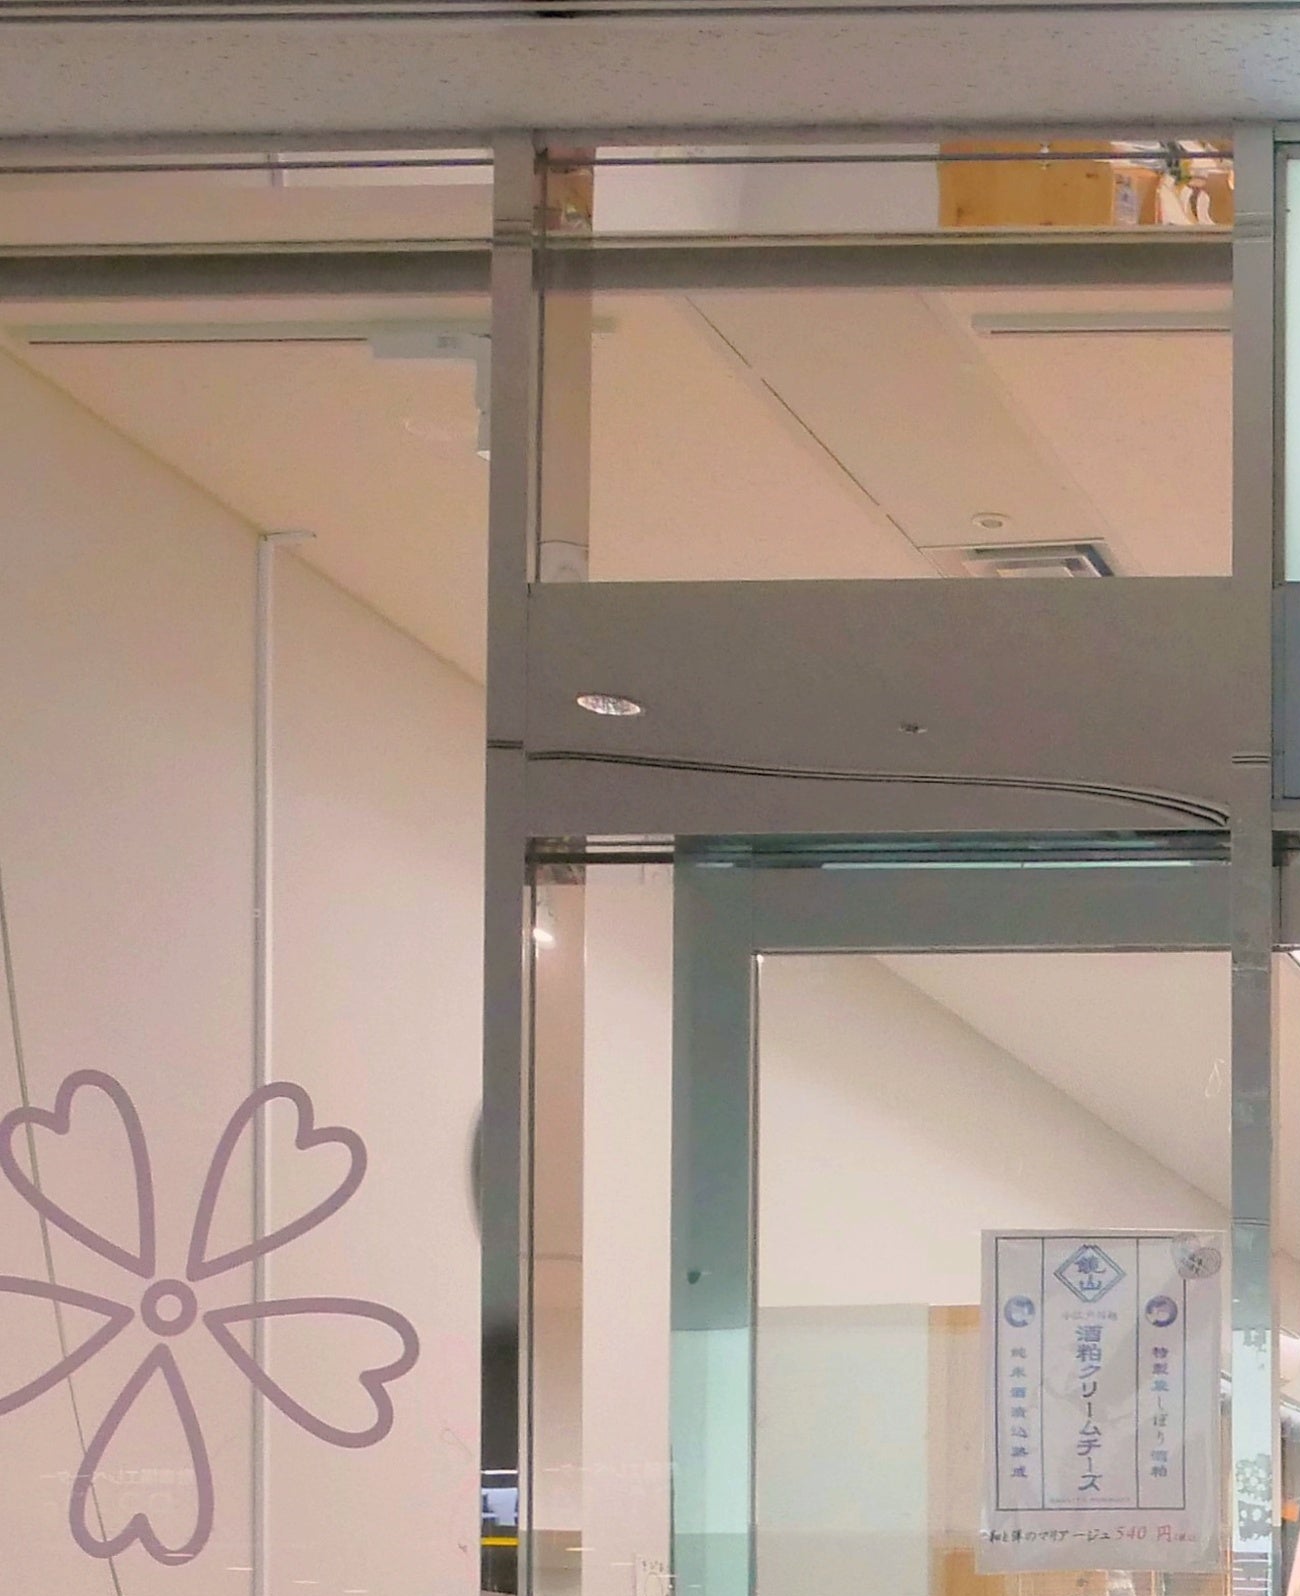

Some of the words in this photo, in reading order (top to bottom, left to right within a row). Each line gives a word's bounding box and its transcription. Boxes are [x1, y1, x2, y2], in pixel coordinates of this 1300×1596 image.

[1075, 1325, 1104, 1491] 酒粕クリームチーズ
